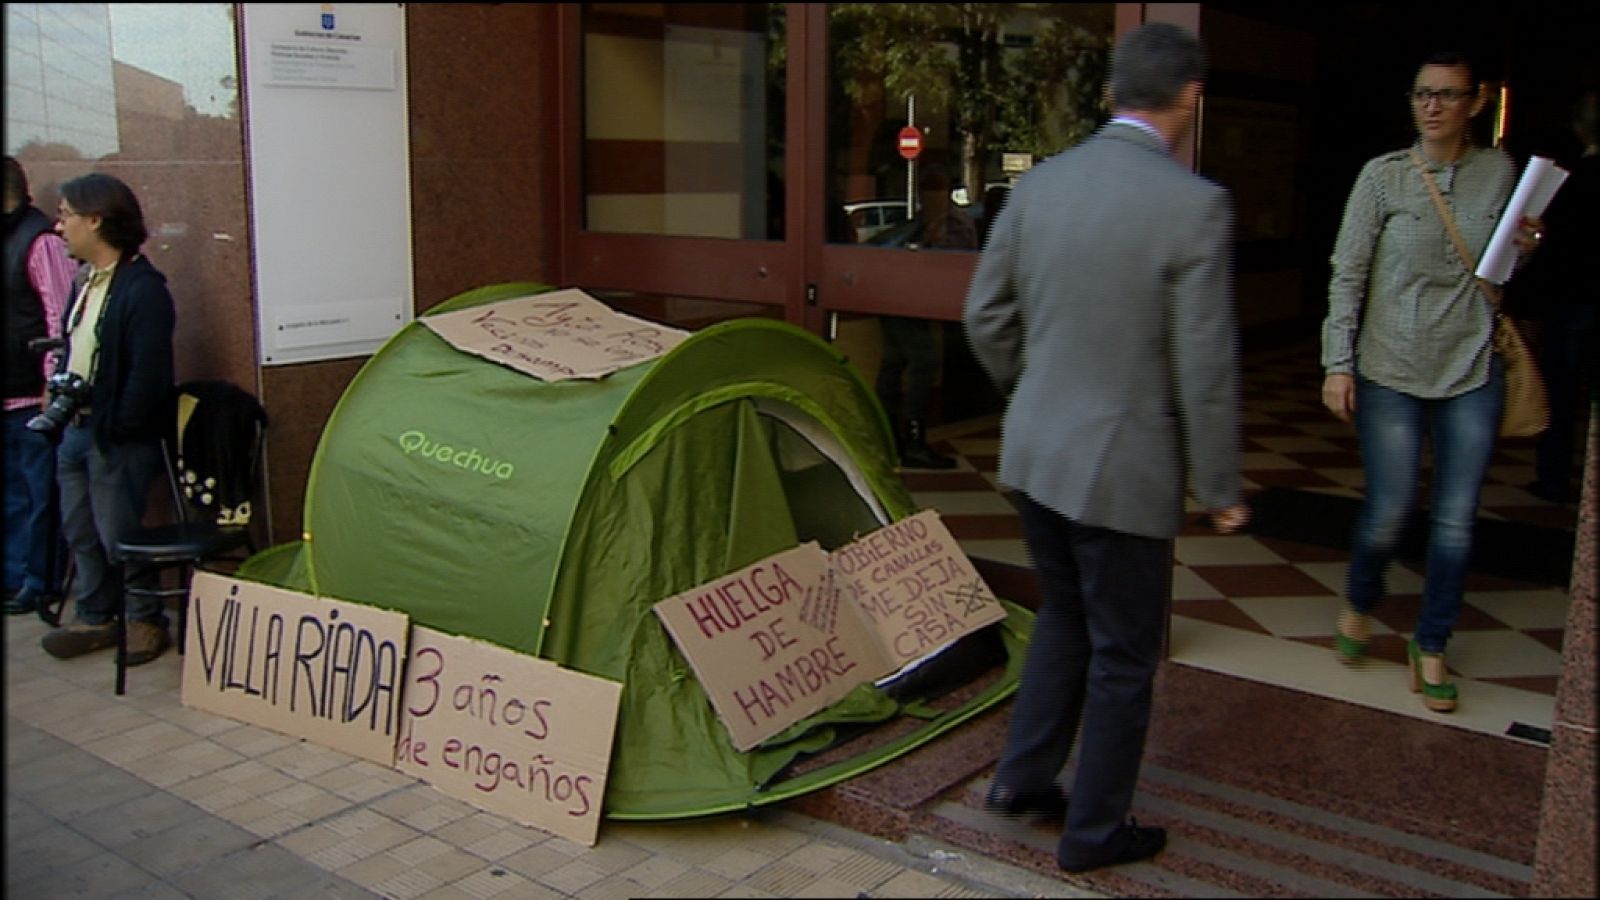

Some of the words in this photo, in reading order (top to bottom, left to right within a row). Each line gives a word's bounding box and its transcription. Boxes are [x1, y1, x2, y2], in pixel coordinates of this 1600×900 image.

[399, 430, 514, 480] Quechua
[836, 518, 928, 575] OBIERNO
[686, 562, 805, 639] HUELGA
[860, 587, 902, 624] ME
[896, 556, 967, 603] DEJA
[904, 592, 949, 629] SIN
[749, 617, 801, 662] DE
[894, 612, 966, 658] CASA
[407, 647, 444, 718] 3
[452, 673, 552, 740] años
[733, 636, 858, 726] HAMBRE
[398, 718, 430, 767] de
[441, 737, 593, 818] engaños
